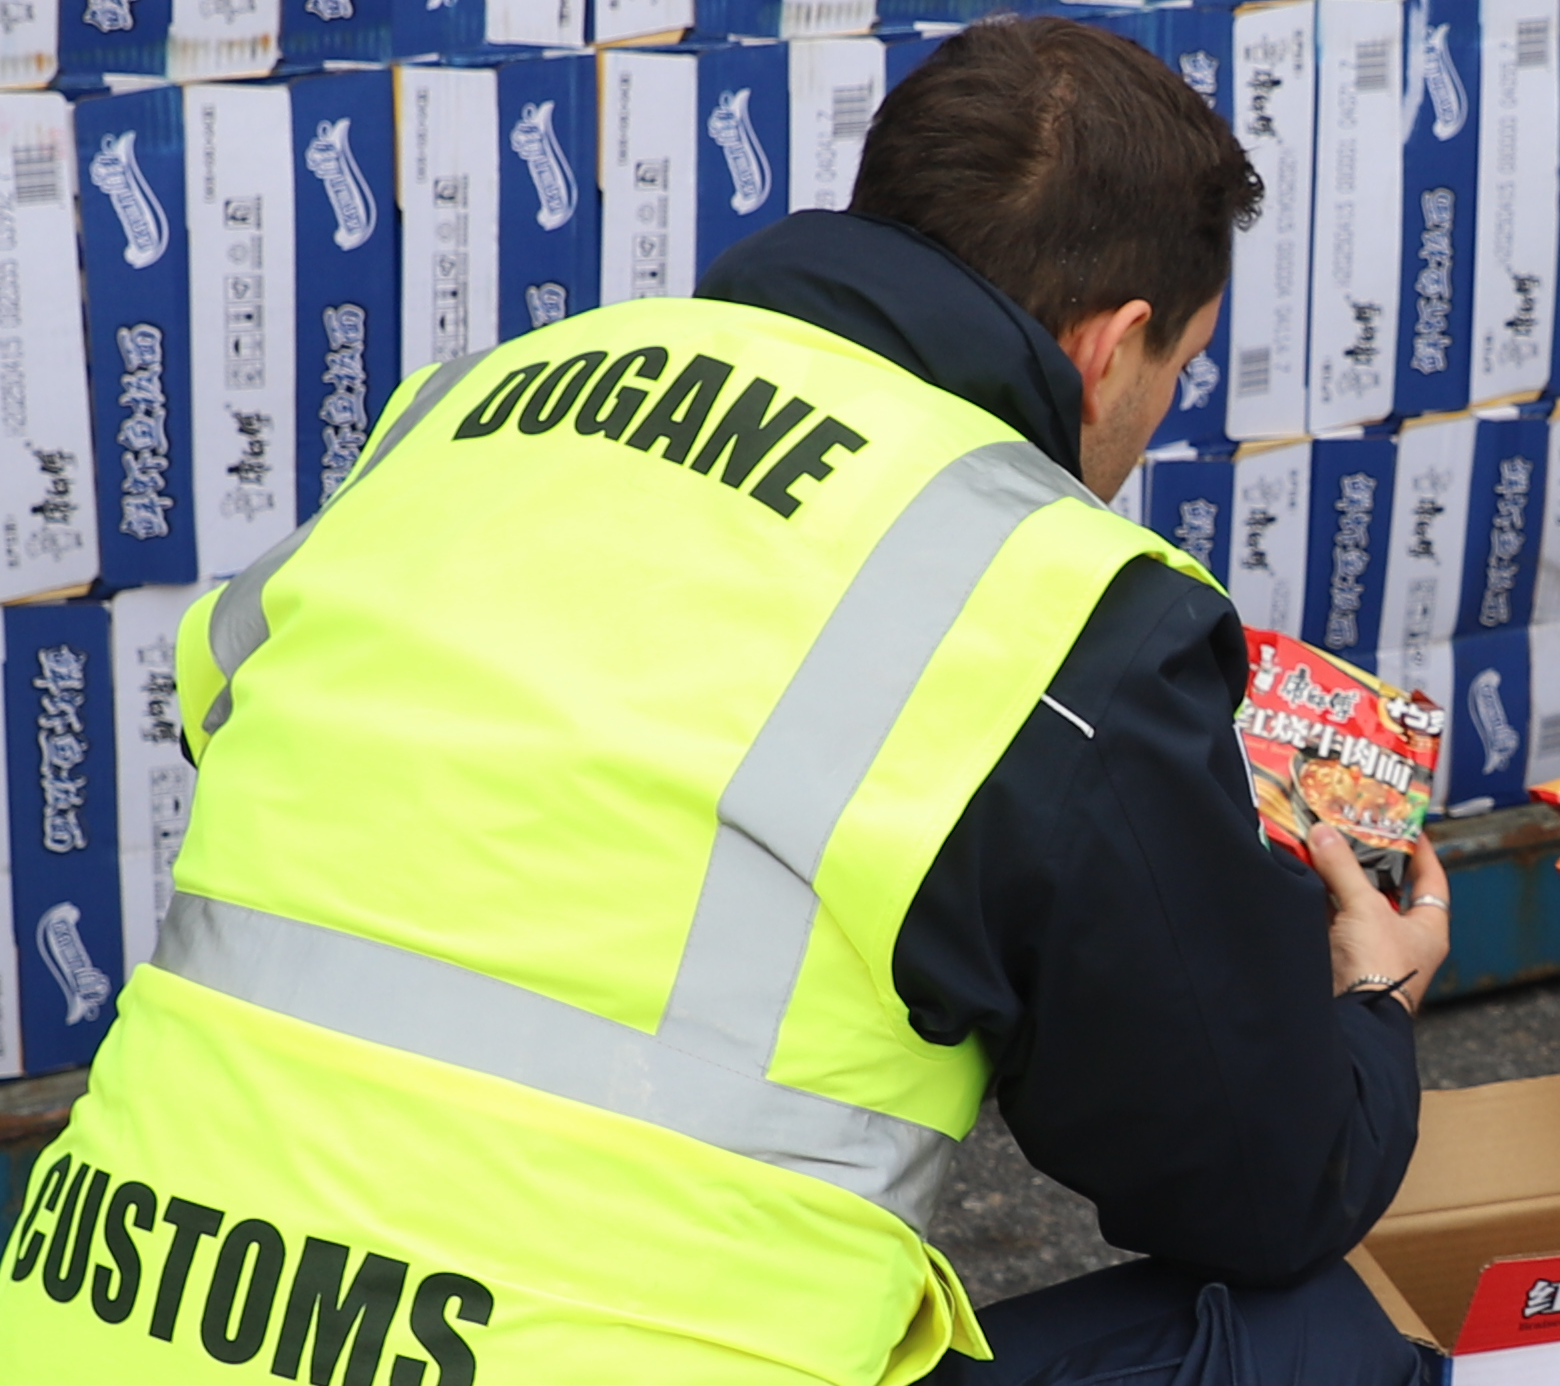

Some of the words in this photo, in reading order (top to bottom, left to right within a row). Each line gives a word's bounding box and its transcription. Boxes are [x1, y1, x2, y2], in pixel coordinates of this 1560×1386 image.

[1413, 189, 1451, 372] 鲜虾鱼板面
[118, 325, 172, 537] 鲜虾鱼板面
[452, 344, 868, 521] DOGANE
[1325, 472, 1377, 650] 鲜虾鱼板面
[35, 647, 86, 851] 鲜虾鱼板面
